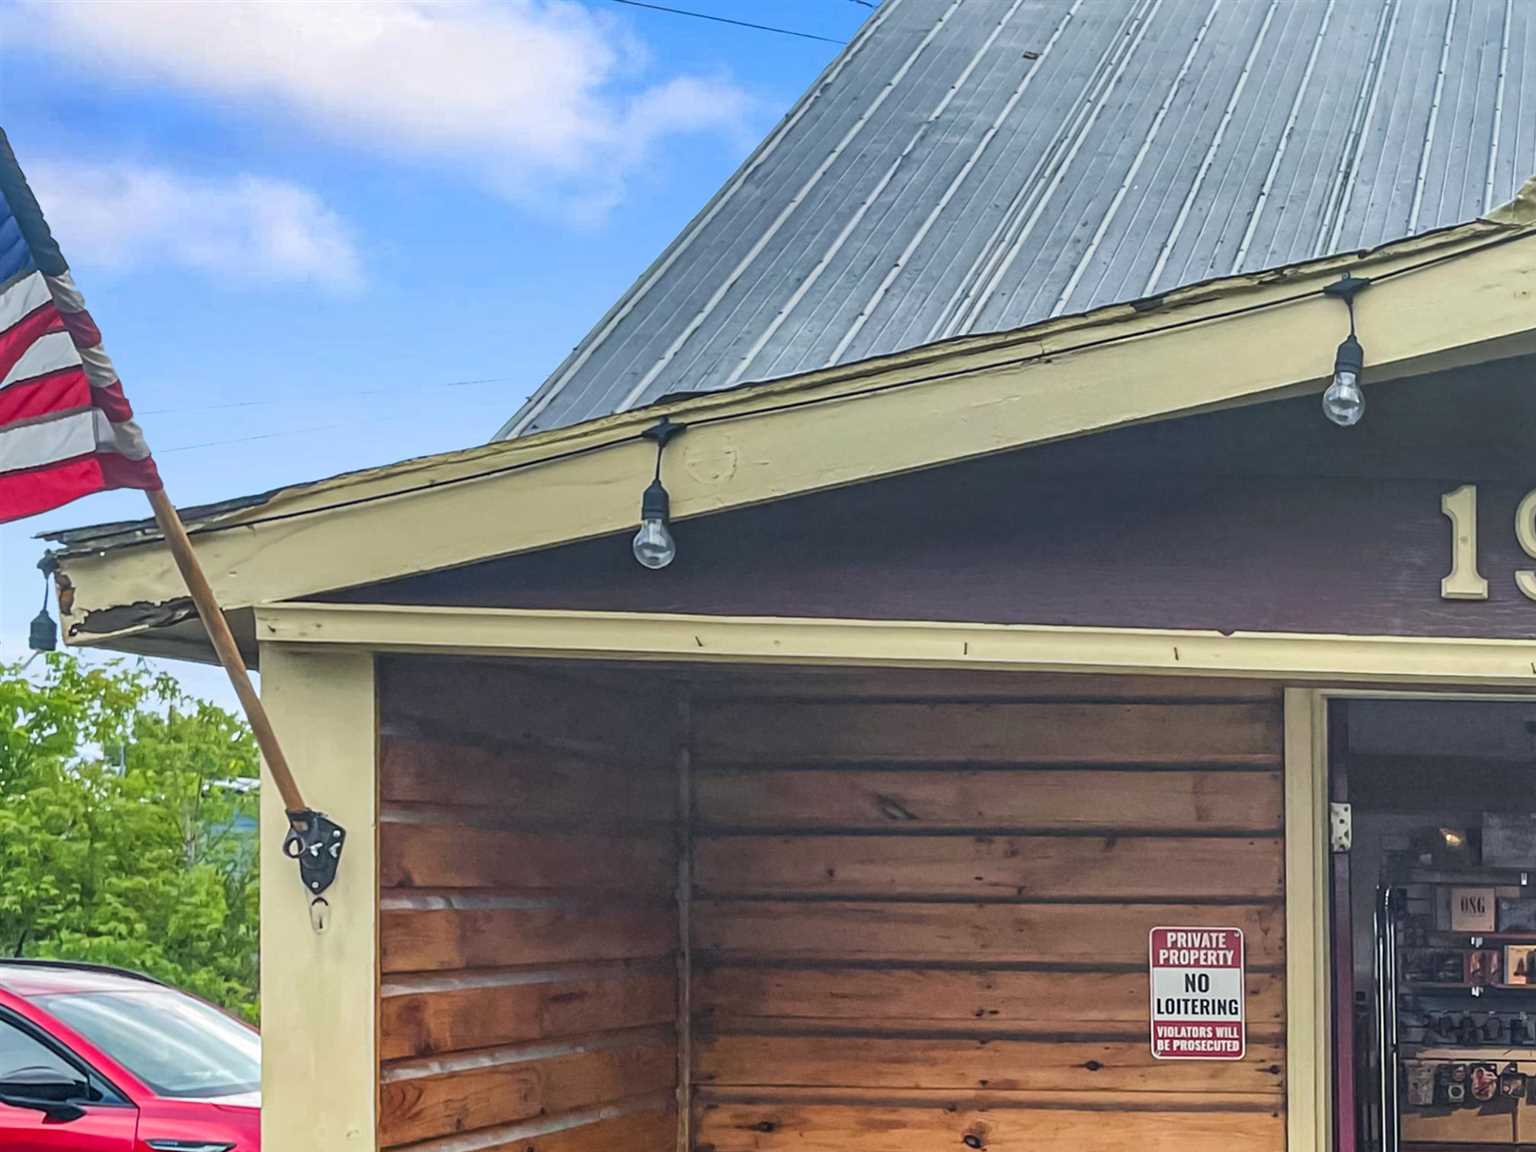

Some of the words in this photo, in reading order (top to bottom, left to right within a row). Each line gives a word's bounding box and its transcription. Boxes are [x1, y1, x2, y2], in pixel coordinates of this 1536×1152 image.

[1167, 932, 1226, 948] PRIVATE
[1159, 949, 1234, 965] PROPERTY
[1184, 973, 1210, 993] NO
[1157, 998, 1239, 1015] LOITERING
[1157, 1026, 1213, 1038] VIOLATORS
[1215, 1026, 1239, 1038] WILL
[1157, 1040, 1170, 1051] BE
[1173, 1040, 1239, 1051] PROSECUTED
